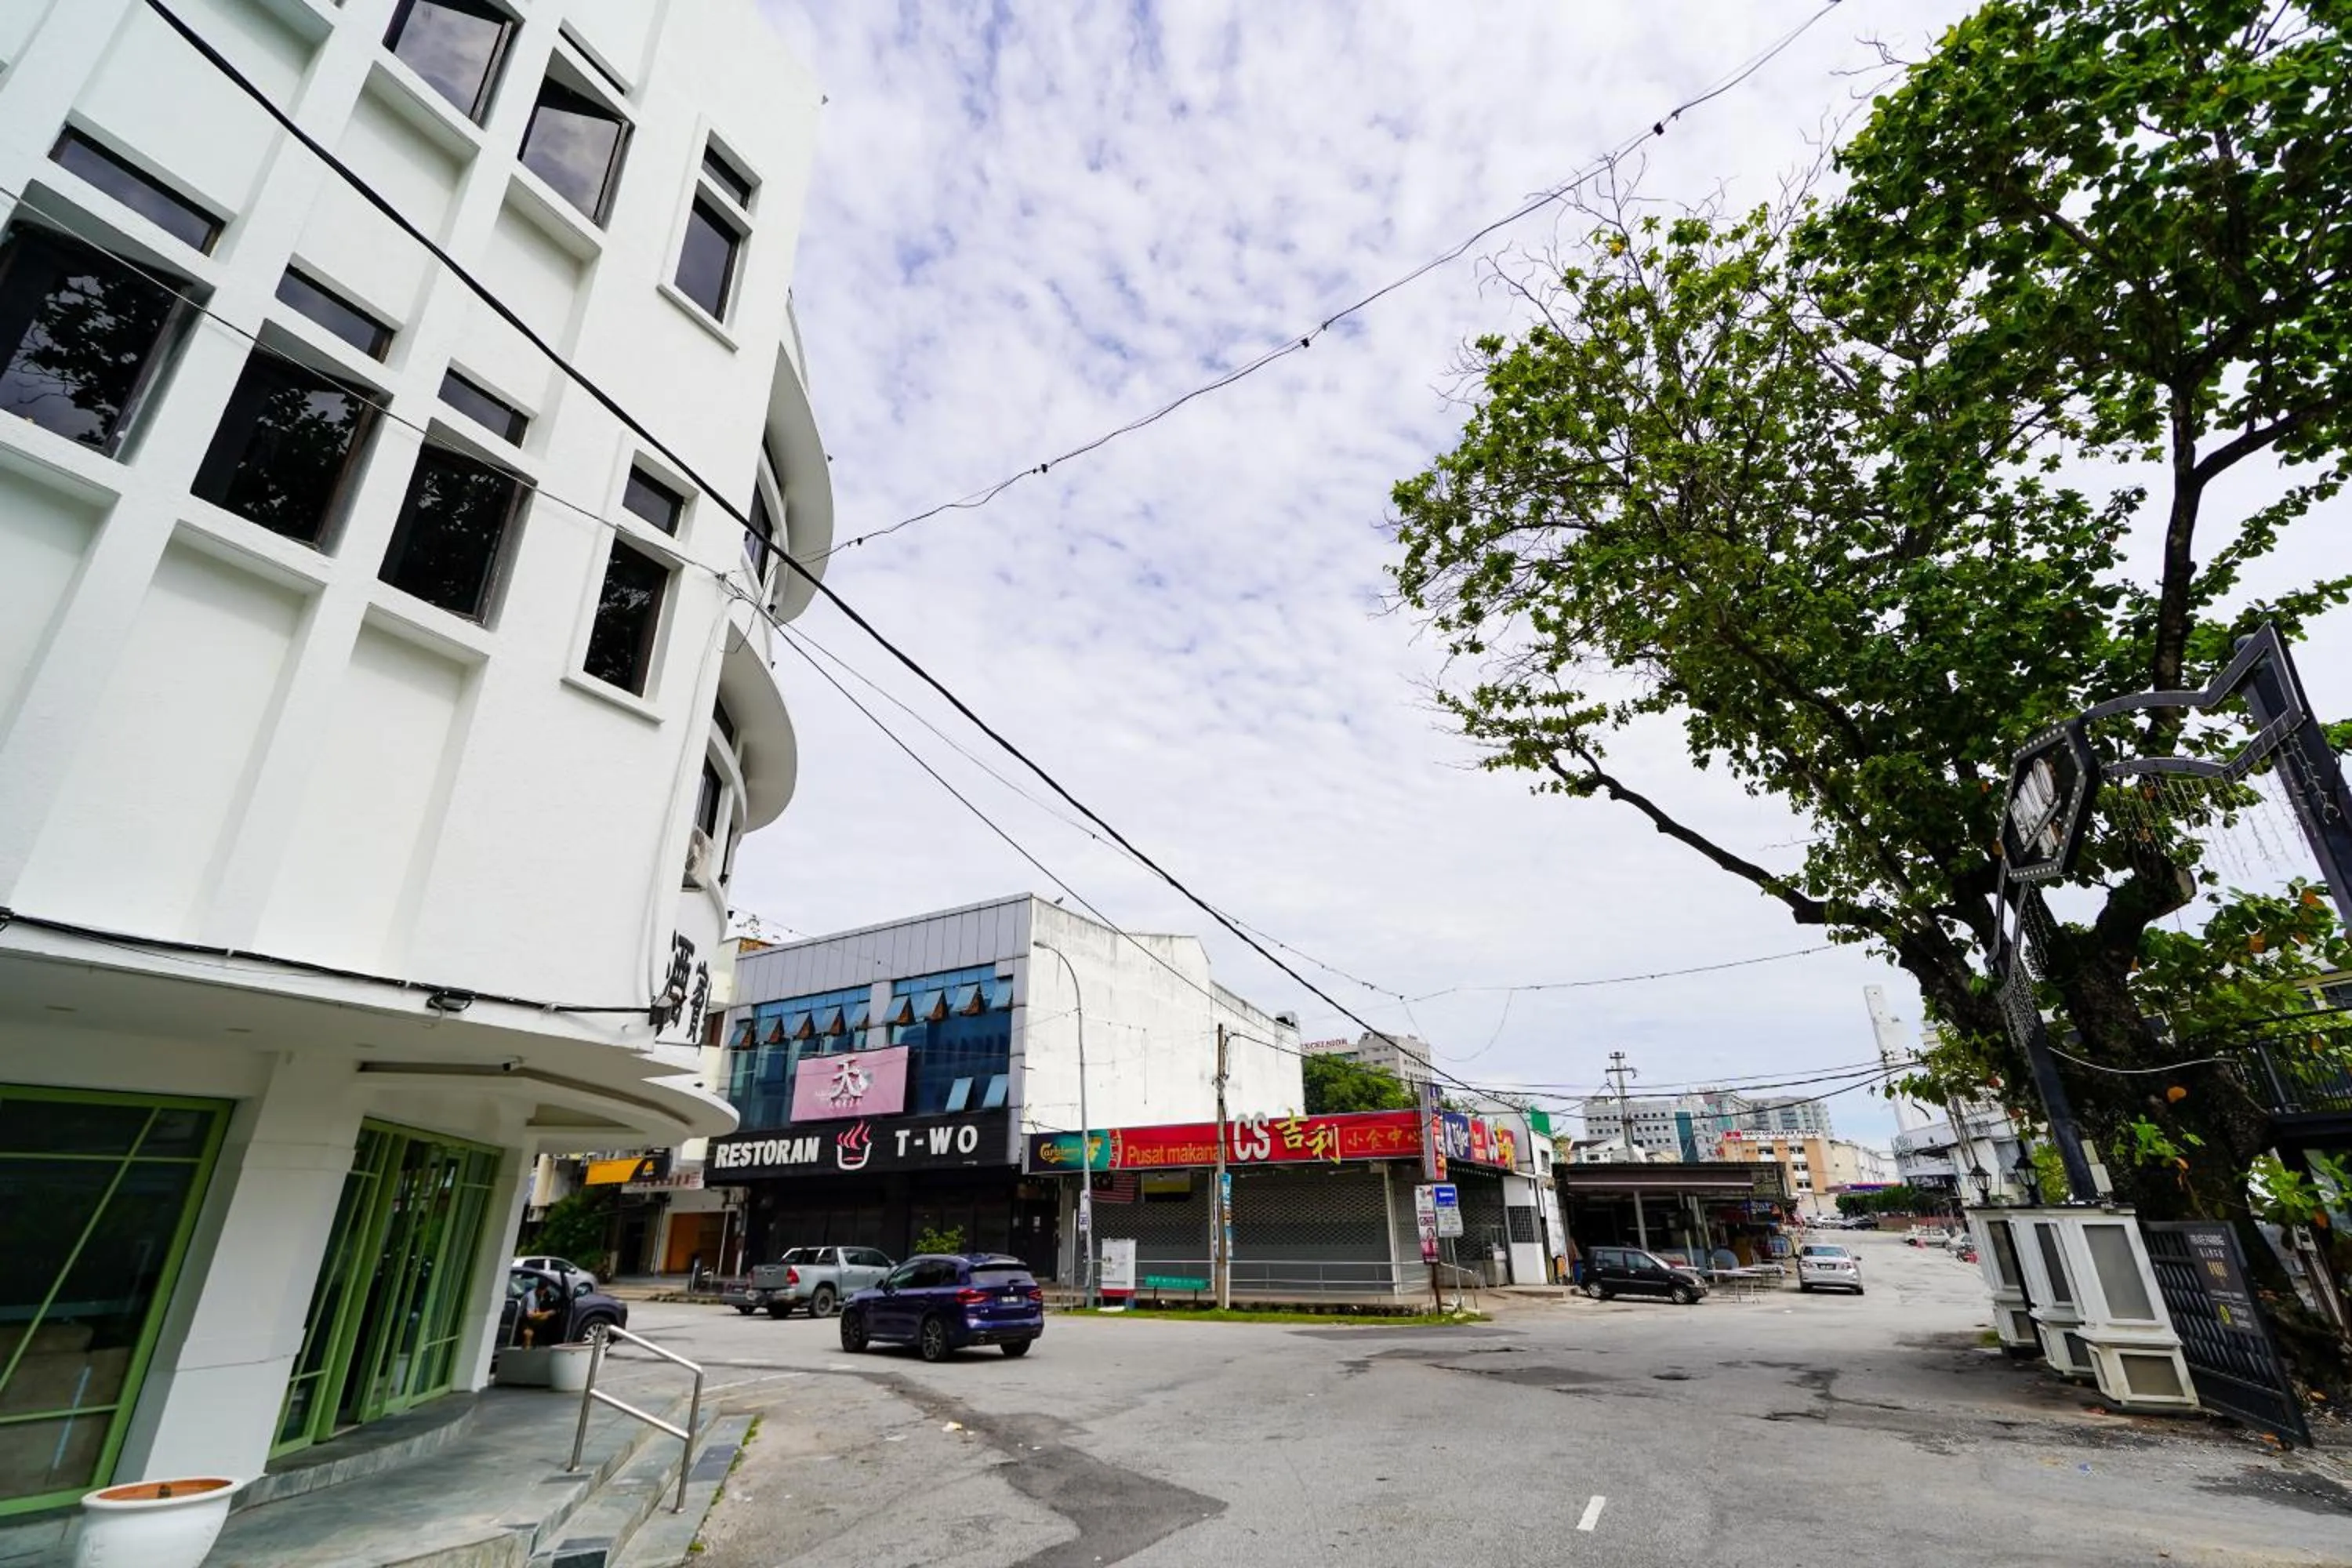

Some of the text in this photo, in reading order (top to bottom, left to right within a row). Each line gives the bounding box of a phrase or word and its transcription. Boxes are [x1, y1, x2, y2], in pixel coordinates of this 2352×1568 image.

[714, 1137, 820, 1168] RESTORAN
[1127, 1145, 1164, 1165] Pusat
[1233, 1112, 1272, 1160] CS
[1276, 1108, 1342, 1165] 吉利
